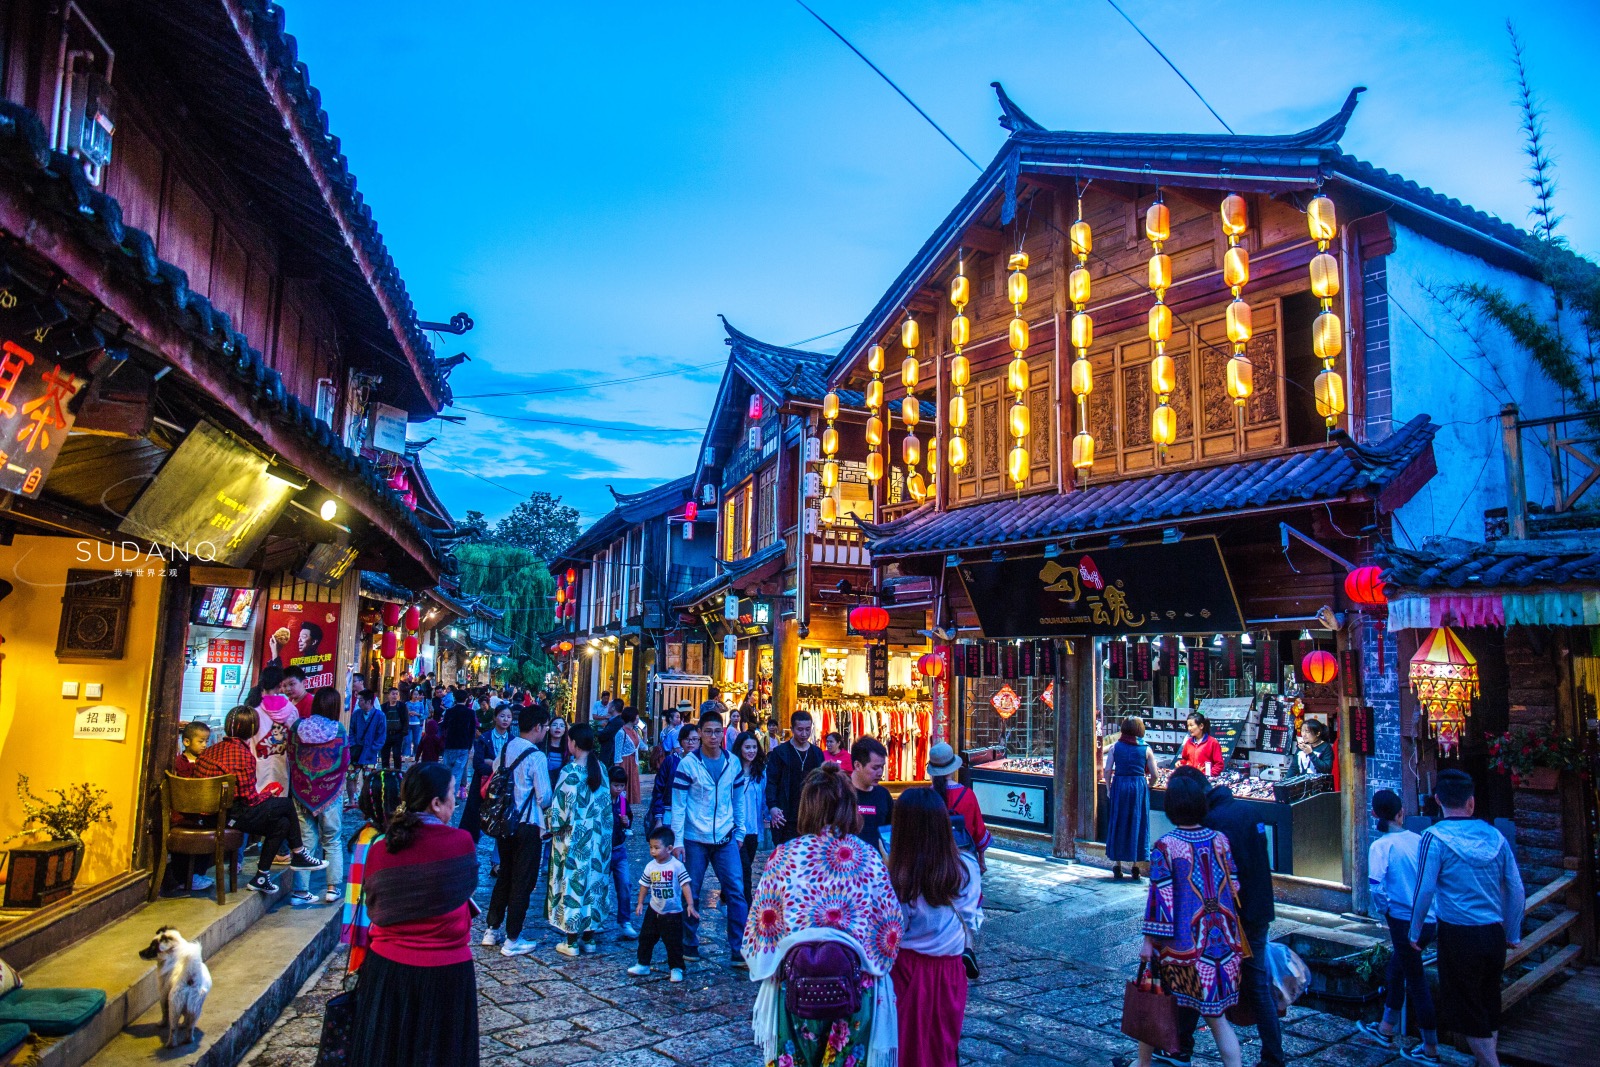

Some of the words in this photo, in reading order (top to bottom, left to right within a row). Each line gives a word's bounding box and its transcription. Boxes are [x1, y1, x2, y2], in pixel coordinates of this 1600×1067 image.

[86, 712, 117, 724] 招聘
[661, 870, 673, 881] 49
[661, 888, 674, 900] 03
